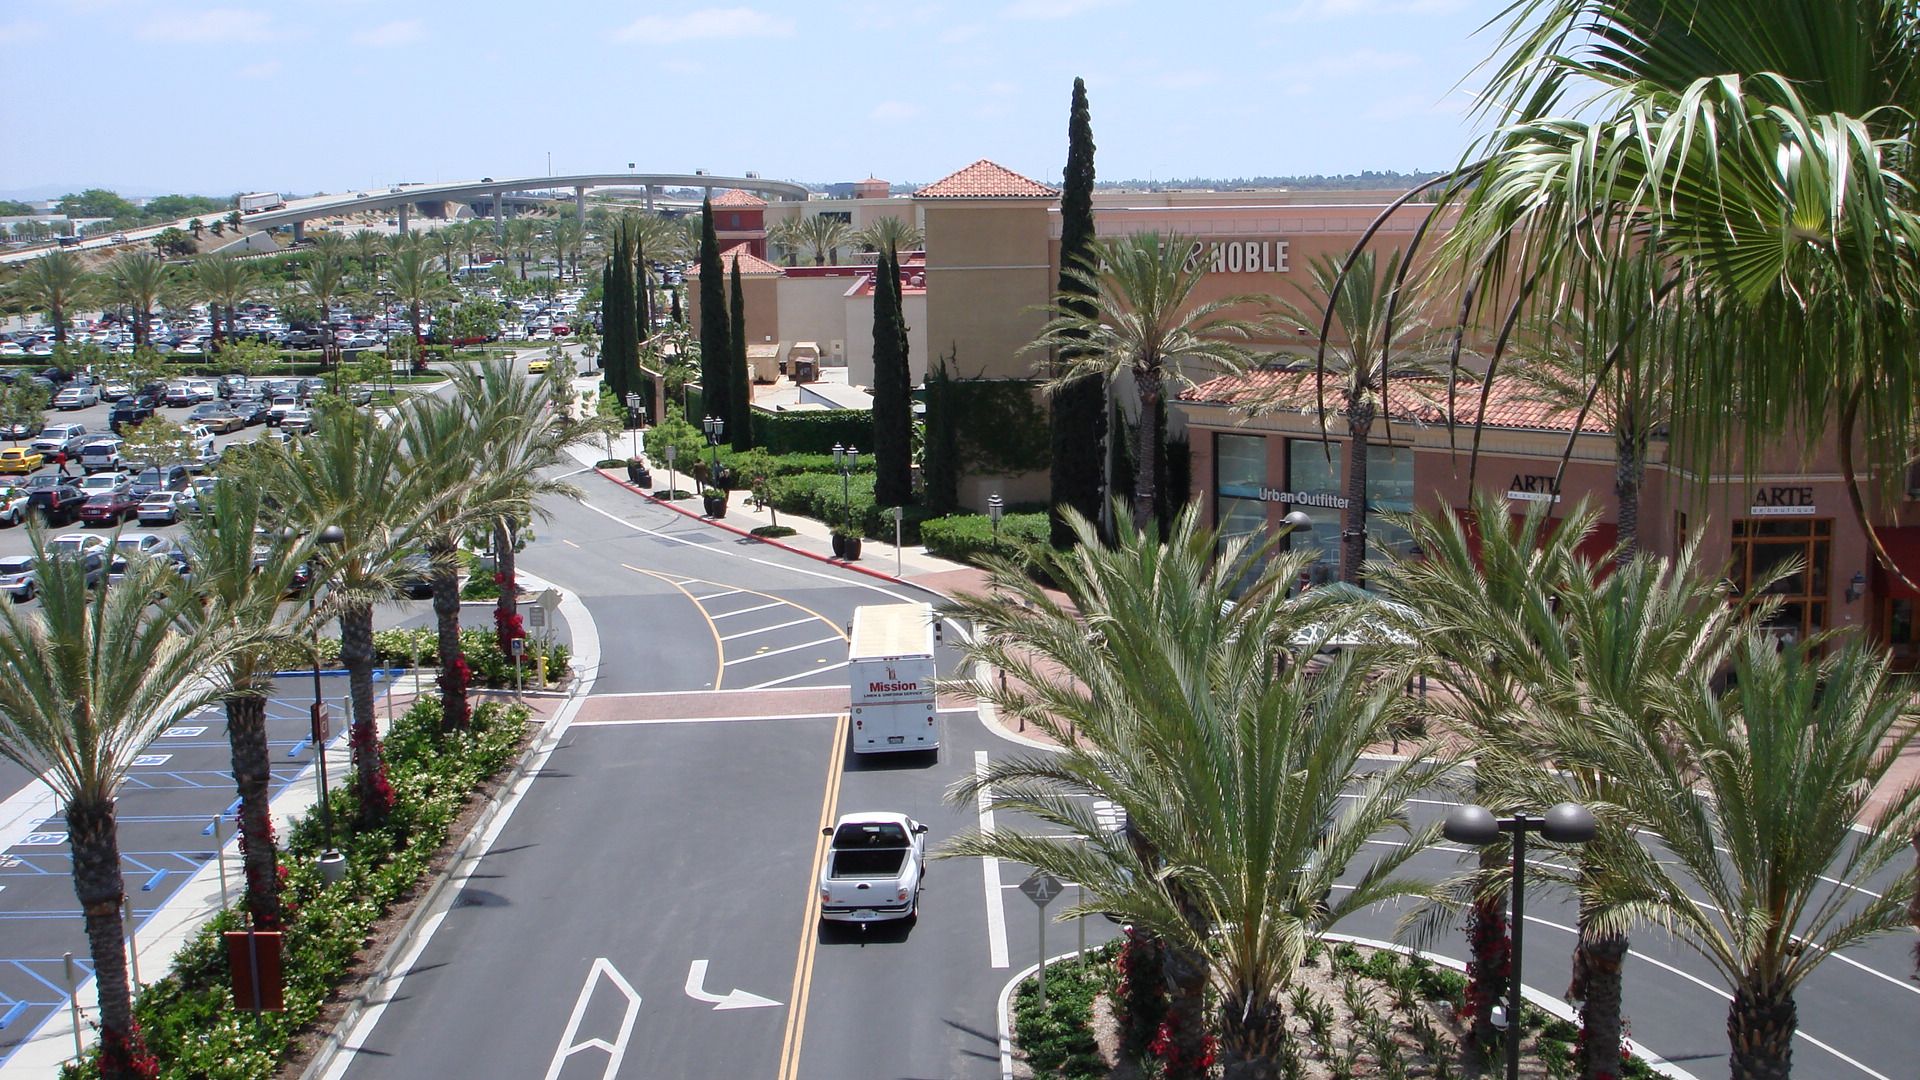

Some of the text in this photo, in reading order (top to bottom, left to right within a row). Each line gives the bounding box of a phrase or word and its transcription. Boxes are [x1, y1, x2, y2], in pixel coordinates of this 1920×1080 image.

[1210, 241, 1290, 273] NOBLE
[1259, 487, 1350, 509] Urban Outfitter
[1753, 487, 1814, 506] ARTE
[869, 681, 917, 692] Mission
